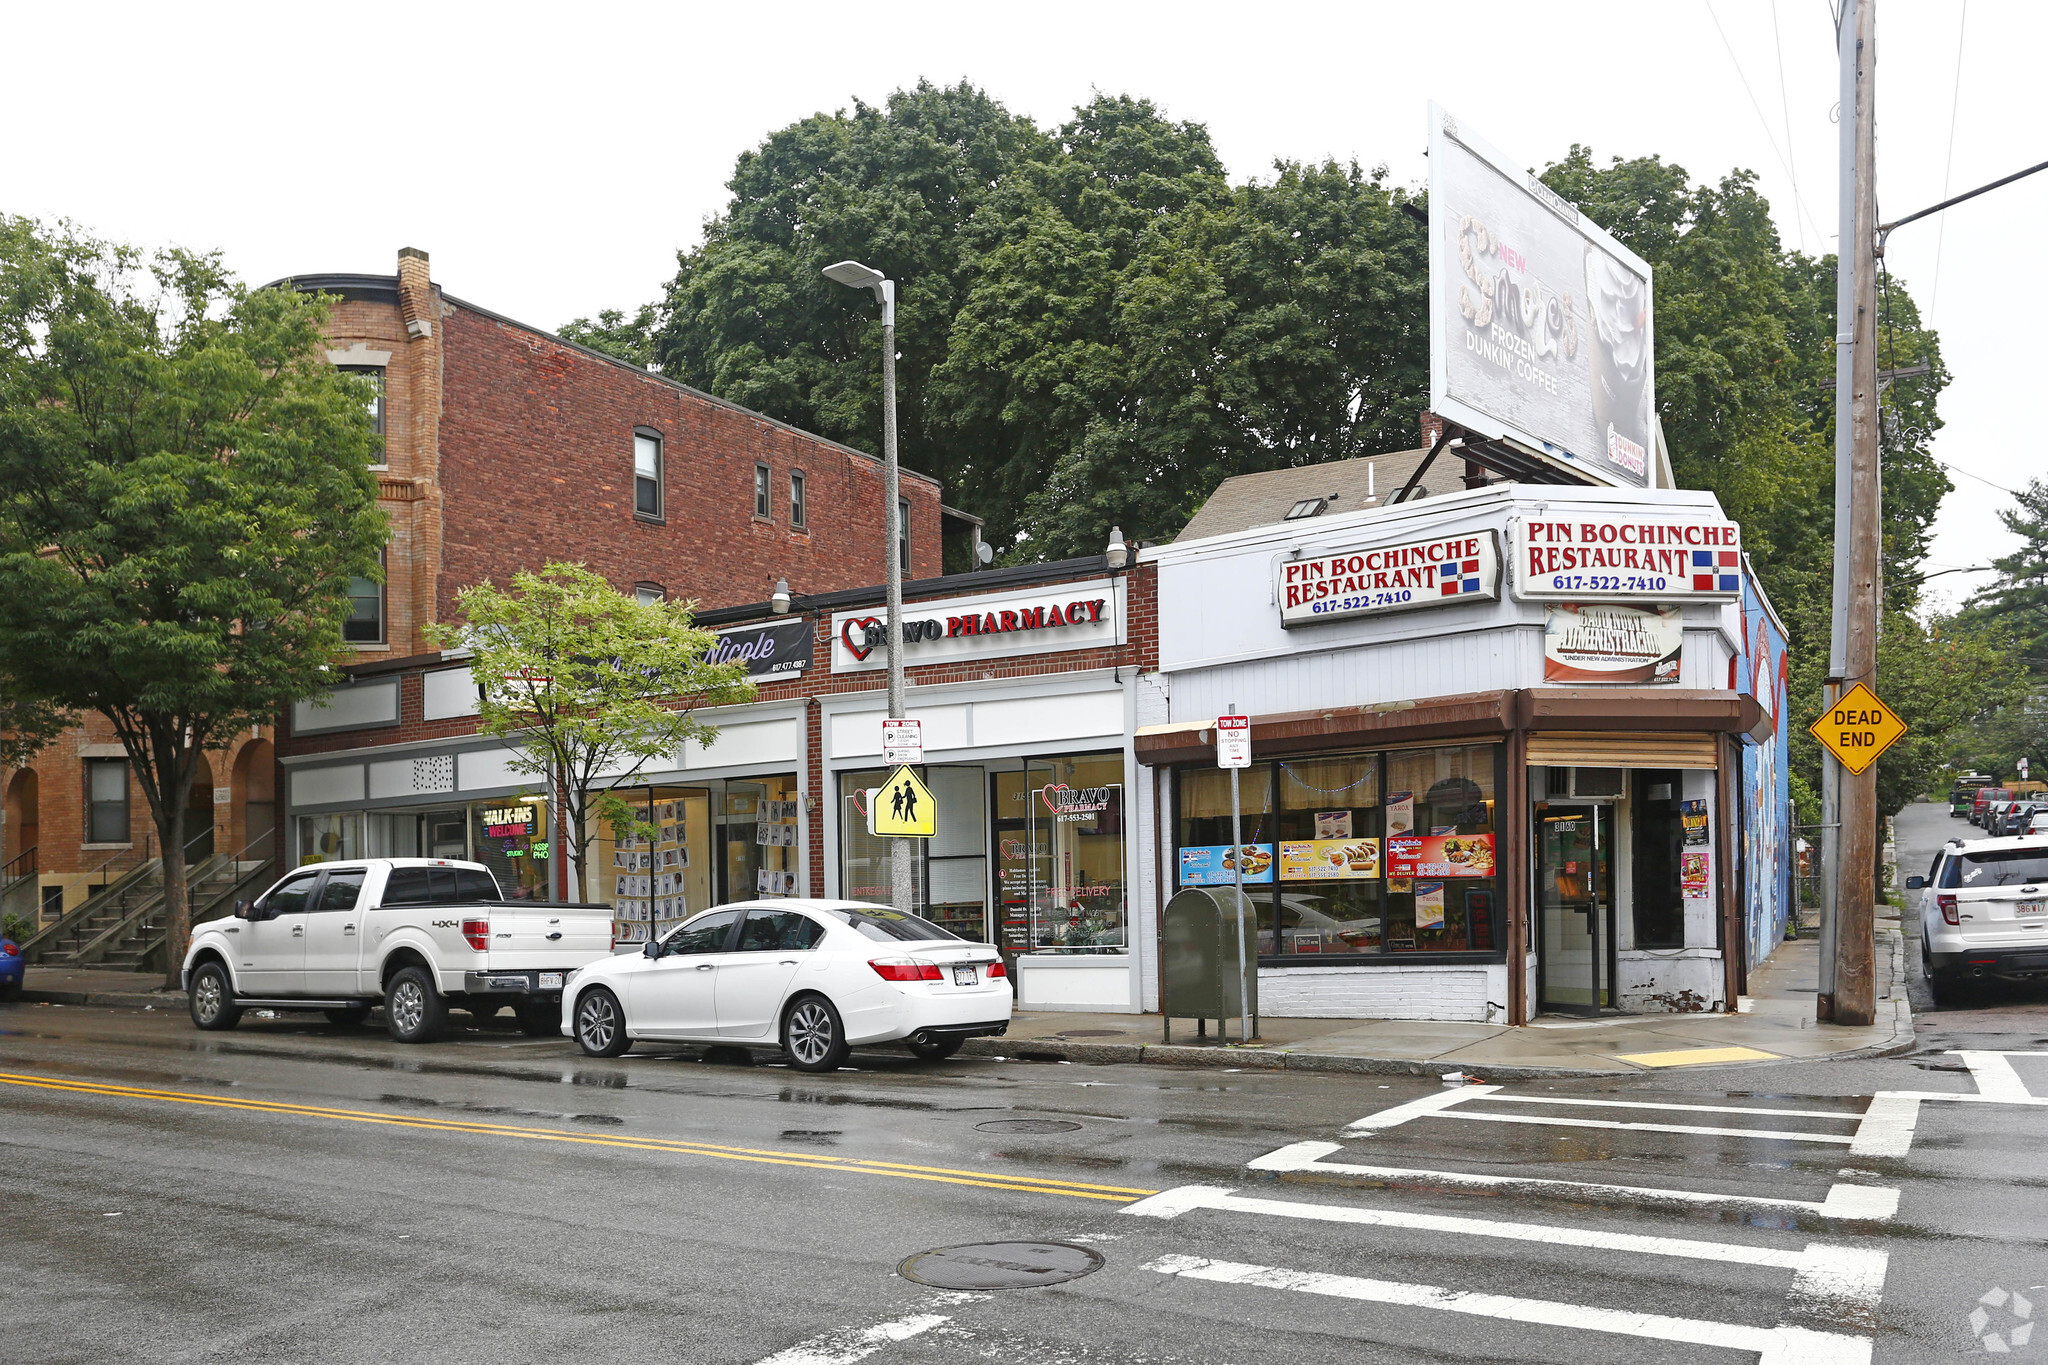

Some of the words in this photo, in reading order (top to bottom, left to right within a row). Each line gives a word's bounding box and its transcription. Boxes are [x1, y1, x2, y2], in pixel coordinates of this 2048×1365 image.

[1499, 242, 1526, 274] NEW
[1491, 322, 1535, 363] FROZEN
[1467, 330, 1513, 371] DUNKIN'
[1516, 358, 1557, 396] COFFEE
[1528, 522, 1572, 543] PIN
[1580, 523, 1738, 546] BOCHINCHE
[1286, 562, 1324, 584] PIN
[1331, 537, 1480, 577] BOCHINCHE
[1528, 547, 1689, 578] RESTAURANT
[1286, 564, 1438, 609] RESTAURANT
[1553, 575, 1667, 591] 617-522-7410
[1312, 589, 1412, 614] 617-522-7410
[945, 598, 1105, 639] PHARMACY
[1220, 719, 1232, 728] TOW
[1233, 718, 1247, 728] ZONE
[1834, 709, 1883, 726] DEAD
[1227, 730, 1240, 738] NO
[1839, 731, 1876, 747] END
[1058, 786, 1110, 806] BRAVO
[1063, 802, 1108, 813] PHARMACY
[488, 823, 527, 838] WELCOME
[851, 885, 887, 897] ENTREGA
[1045, 887, 1067, 898] FREE
[1069, 885, 1112, 897] DELIVERY
[432, 920, 459, 928] 4X4
